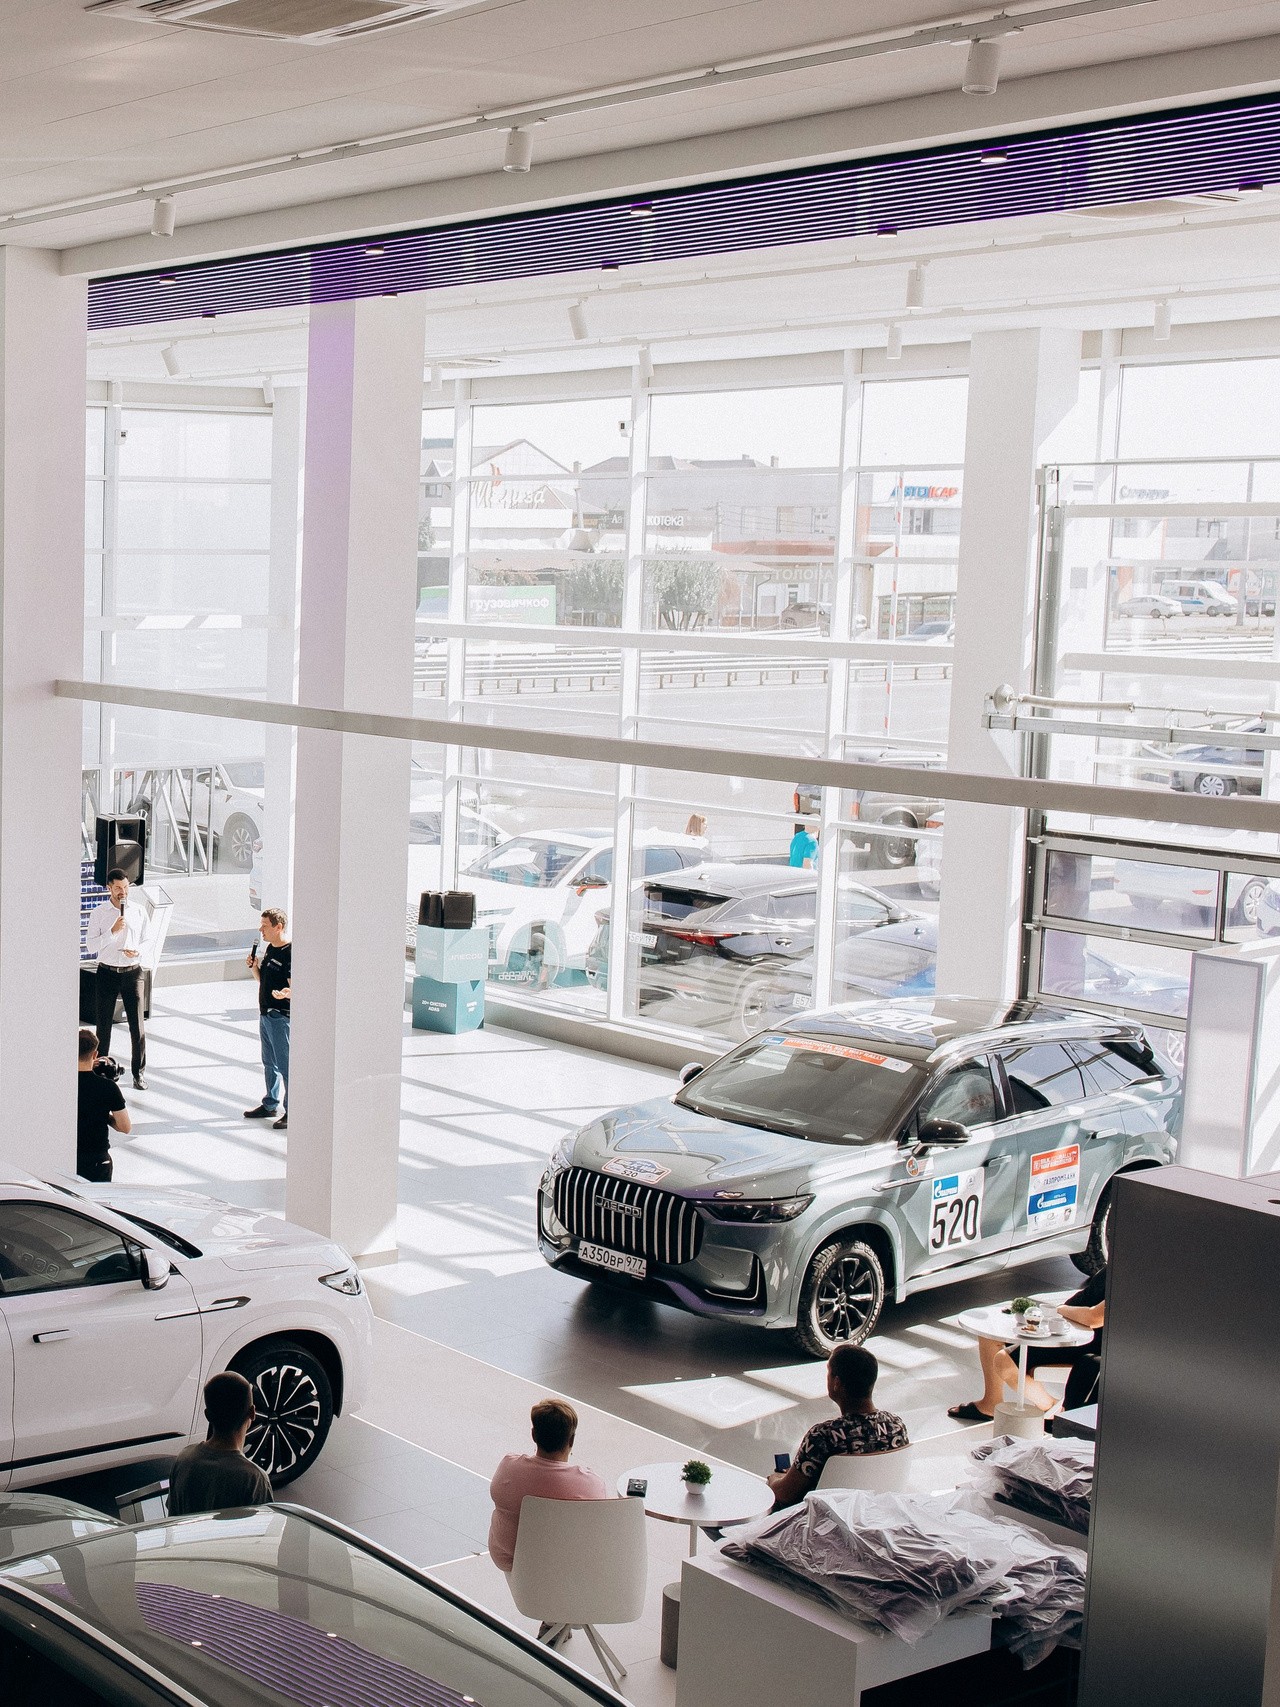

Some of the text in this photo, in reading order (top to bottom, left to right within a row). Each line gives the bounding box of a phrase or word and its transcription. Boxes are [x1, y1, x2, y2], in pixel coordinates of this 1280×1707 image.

[767, 568, 835, 581] ТОЛОВА
[787, 1038, 833, 1049] INTERNATIONAL
[849, 1047, 863, 1056] WAY
[864, 1051, 885, 1061] RALLY
[621, 1169, 638, 1178] 520
[931, 1194, 979, 1249] 520
[581, 1245, 643, 1270] А350ВР 977
